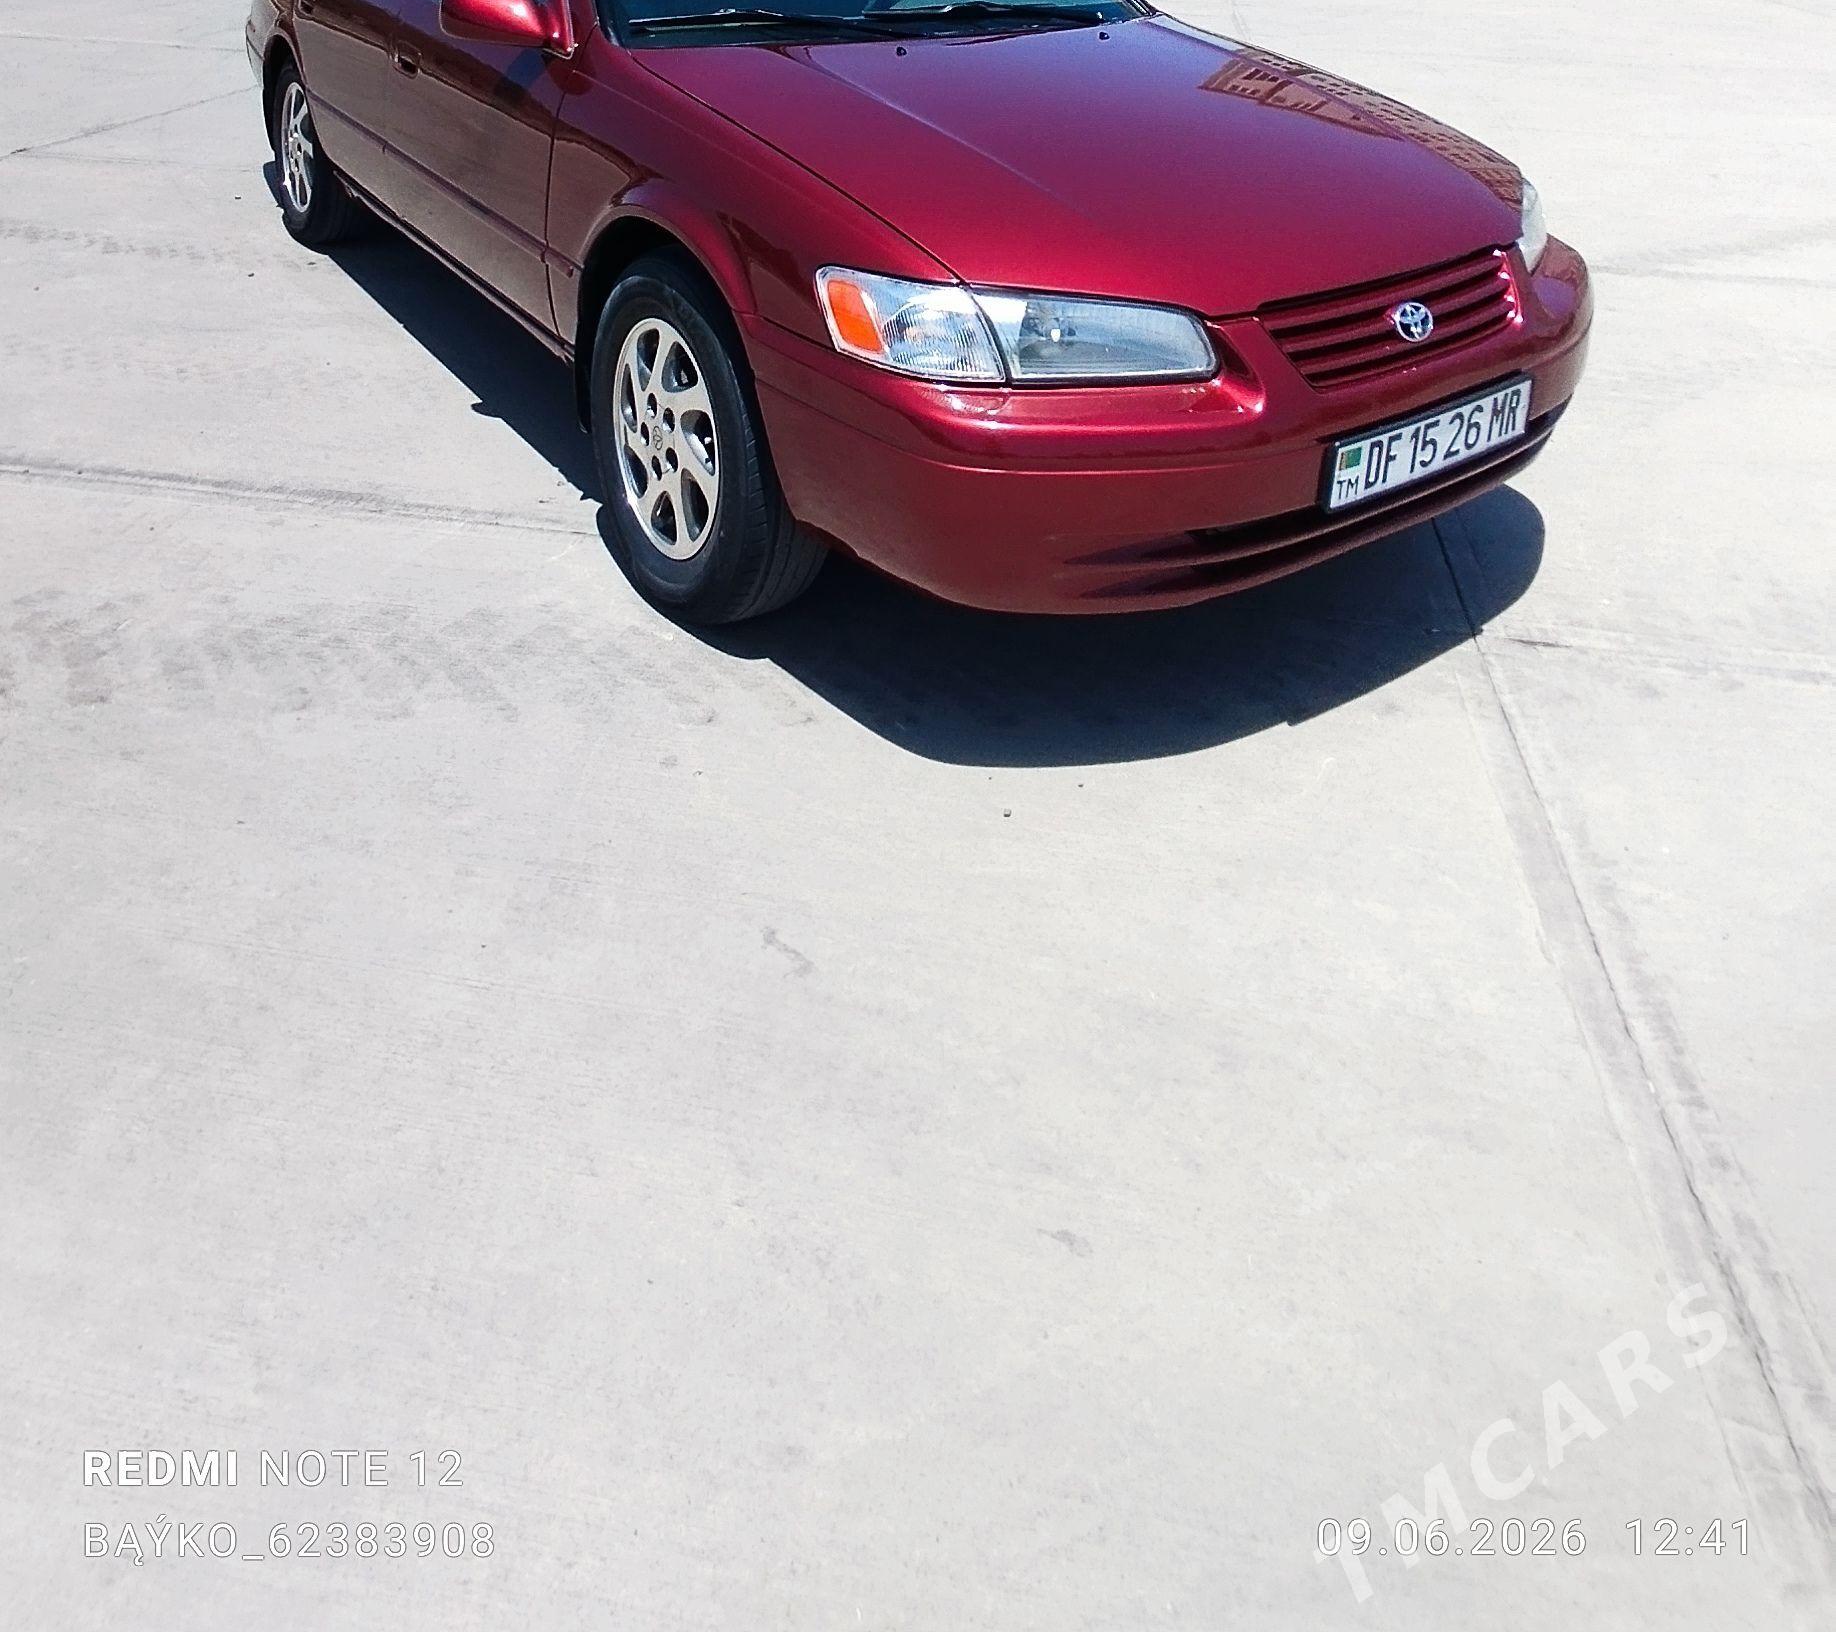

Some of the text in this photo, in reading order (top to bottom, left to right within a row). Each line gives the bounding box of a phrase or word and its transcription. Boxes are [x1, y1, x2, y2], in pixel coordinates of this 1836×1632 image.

[1364, 388, 1522, 490] DF 15 26 MR
[1336, 475, 1360, 499] TM
